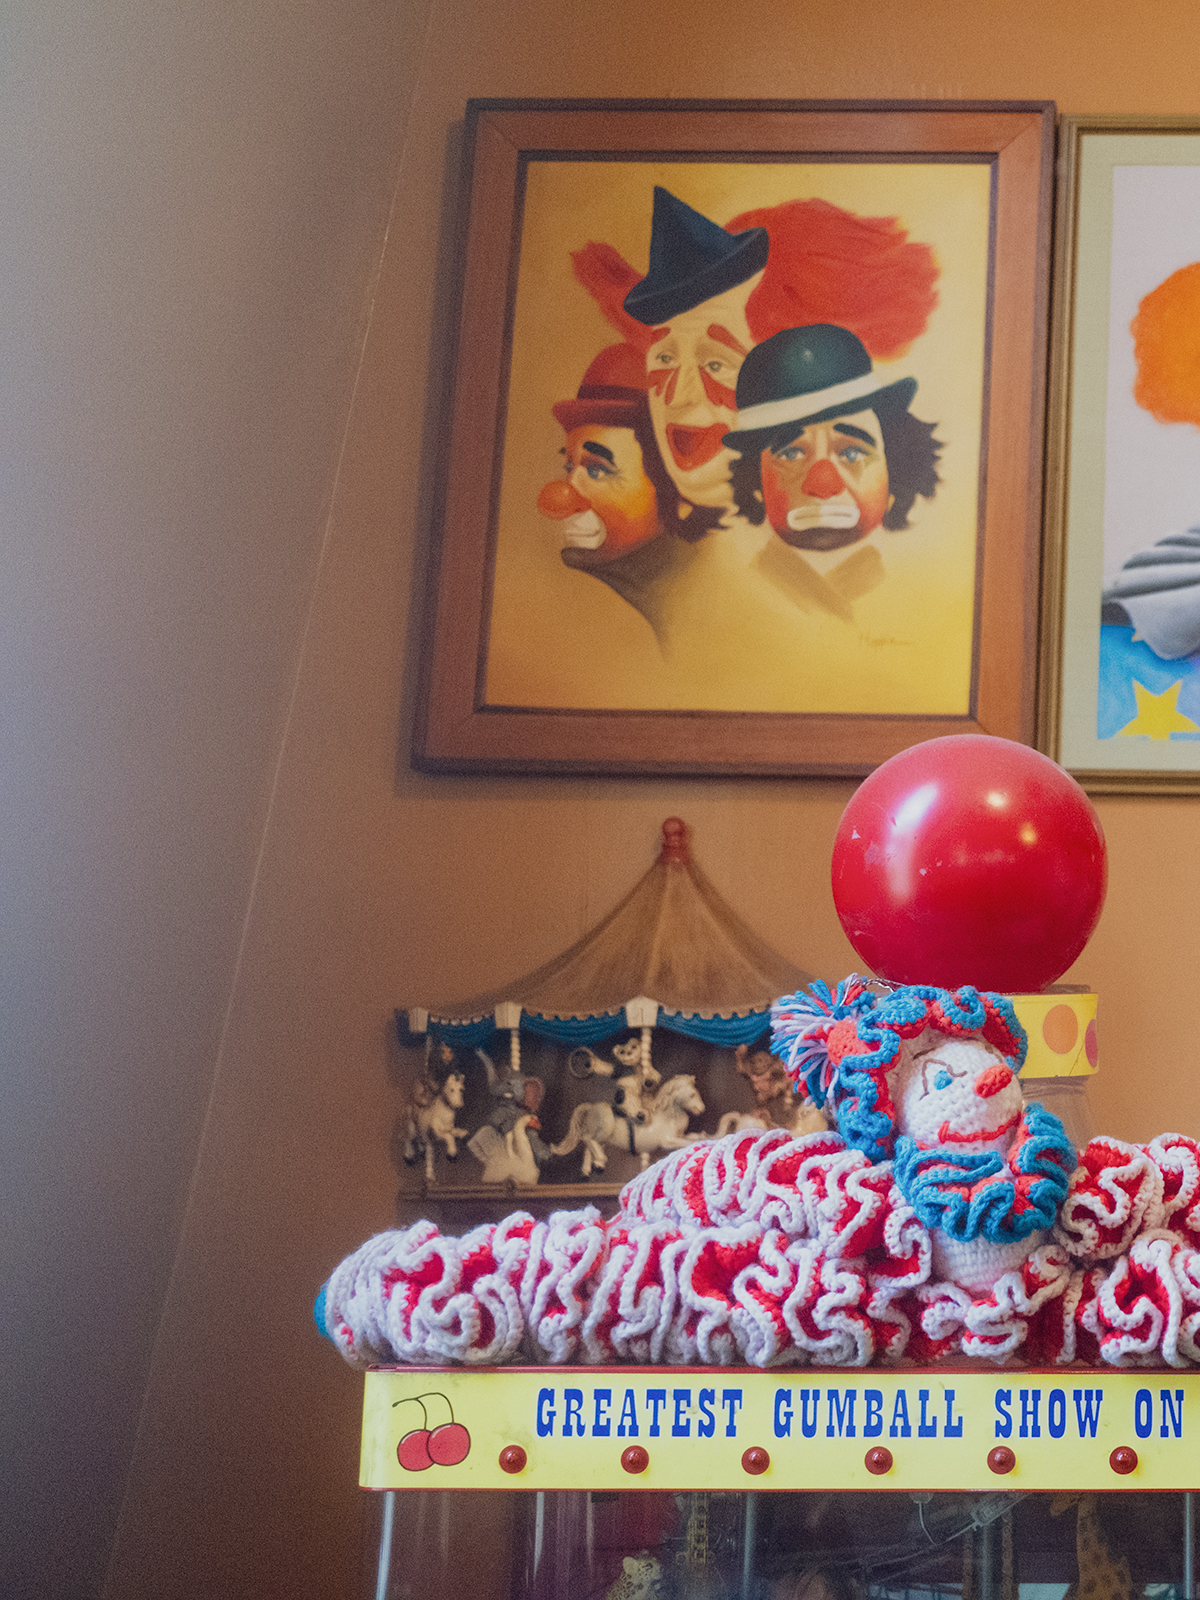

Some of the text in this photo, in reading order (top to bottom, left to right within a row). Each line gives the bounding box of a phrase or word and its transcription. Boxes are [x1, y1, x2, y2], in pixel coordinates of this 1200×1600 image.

[536, 1387, 743, 1438] GREATEST
[773, 1388, 964, 1438] GUMBALL
[994, 1388, 1104, 1438] SHOW
[1134, 1388, 1185, 1438] ON
